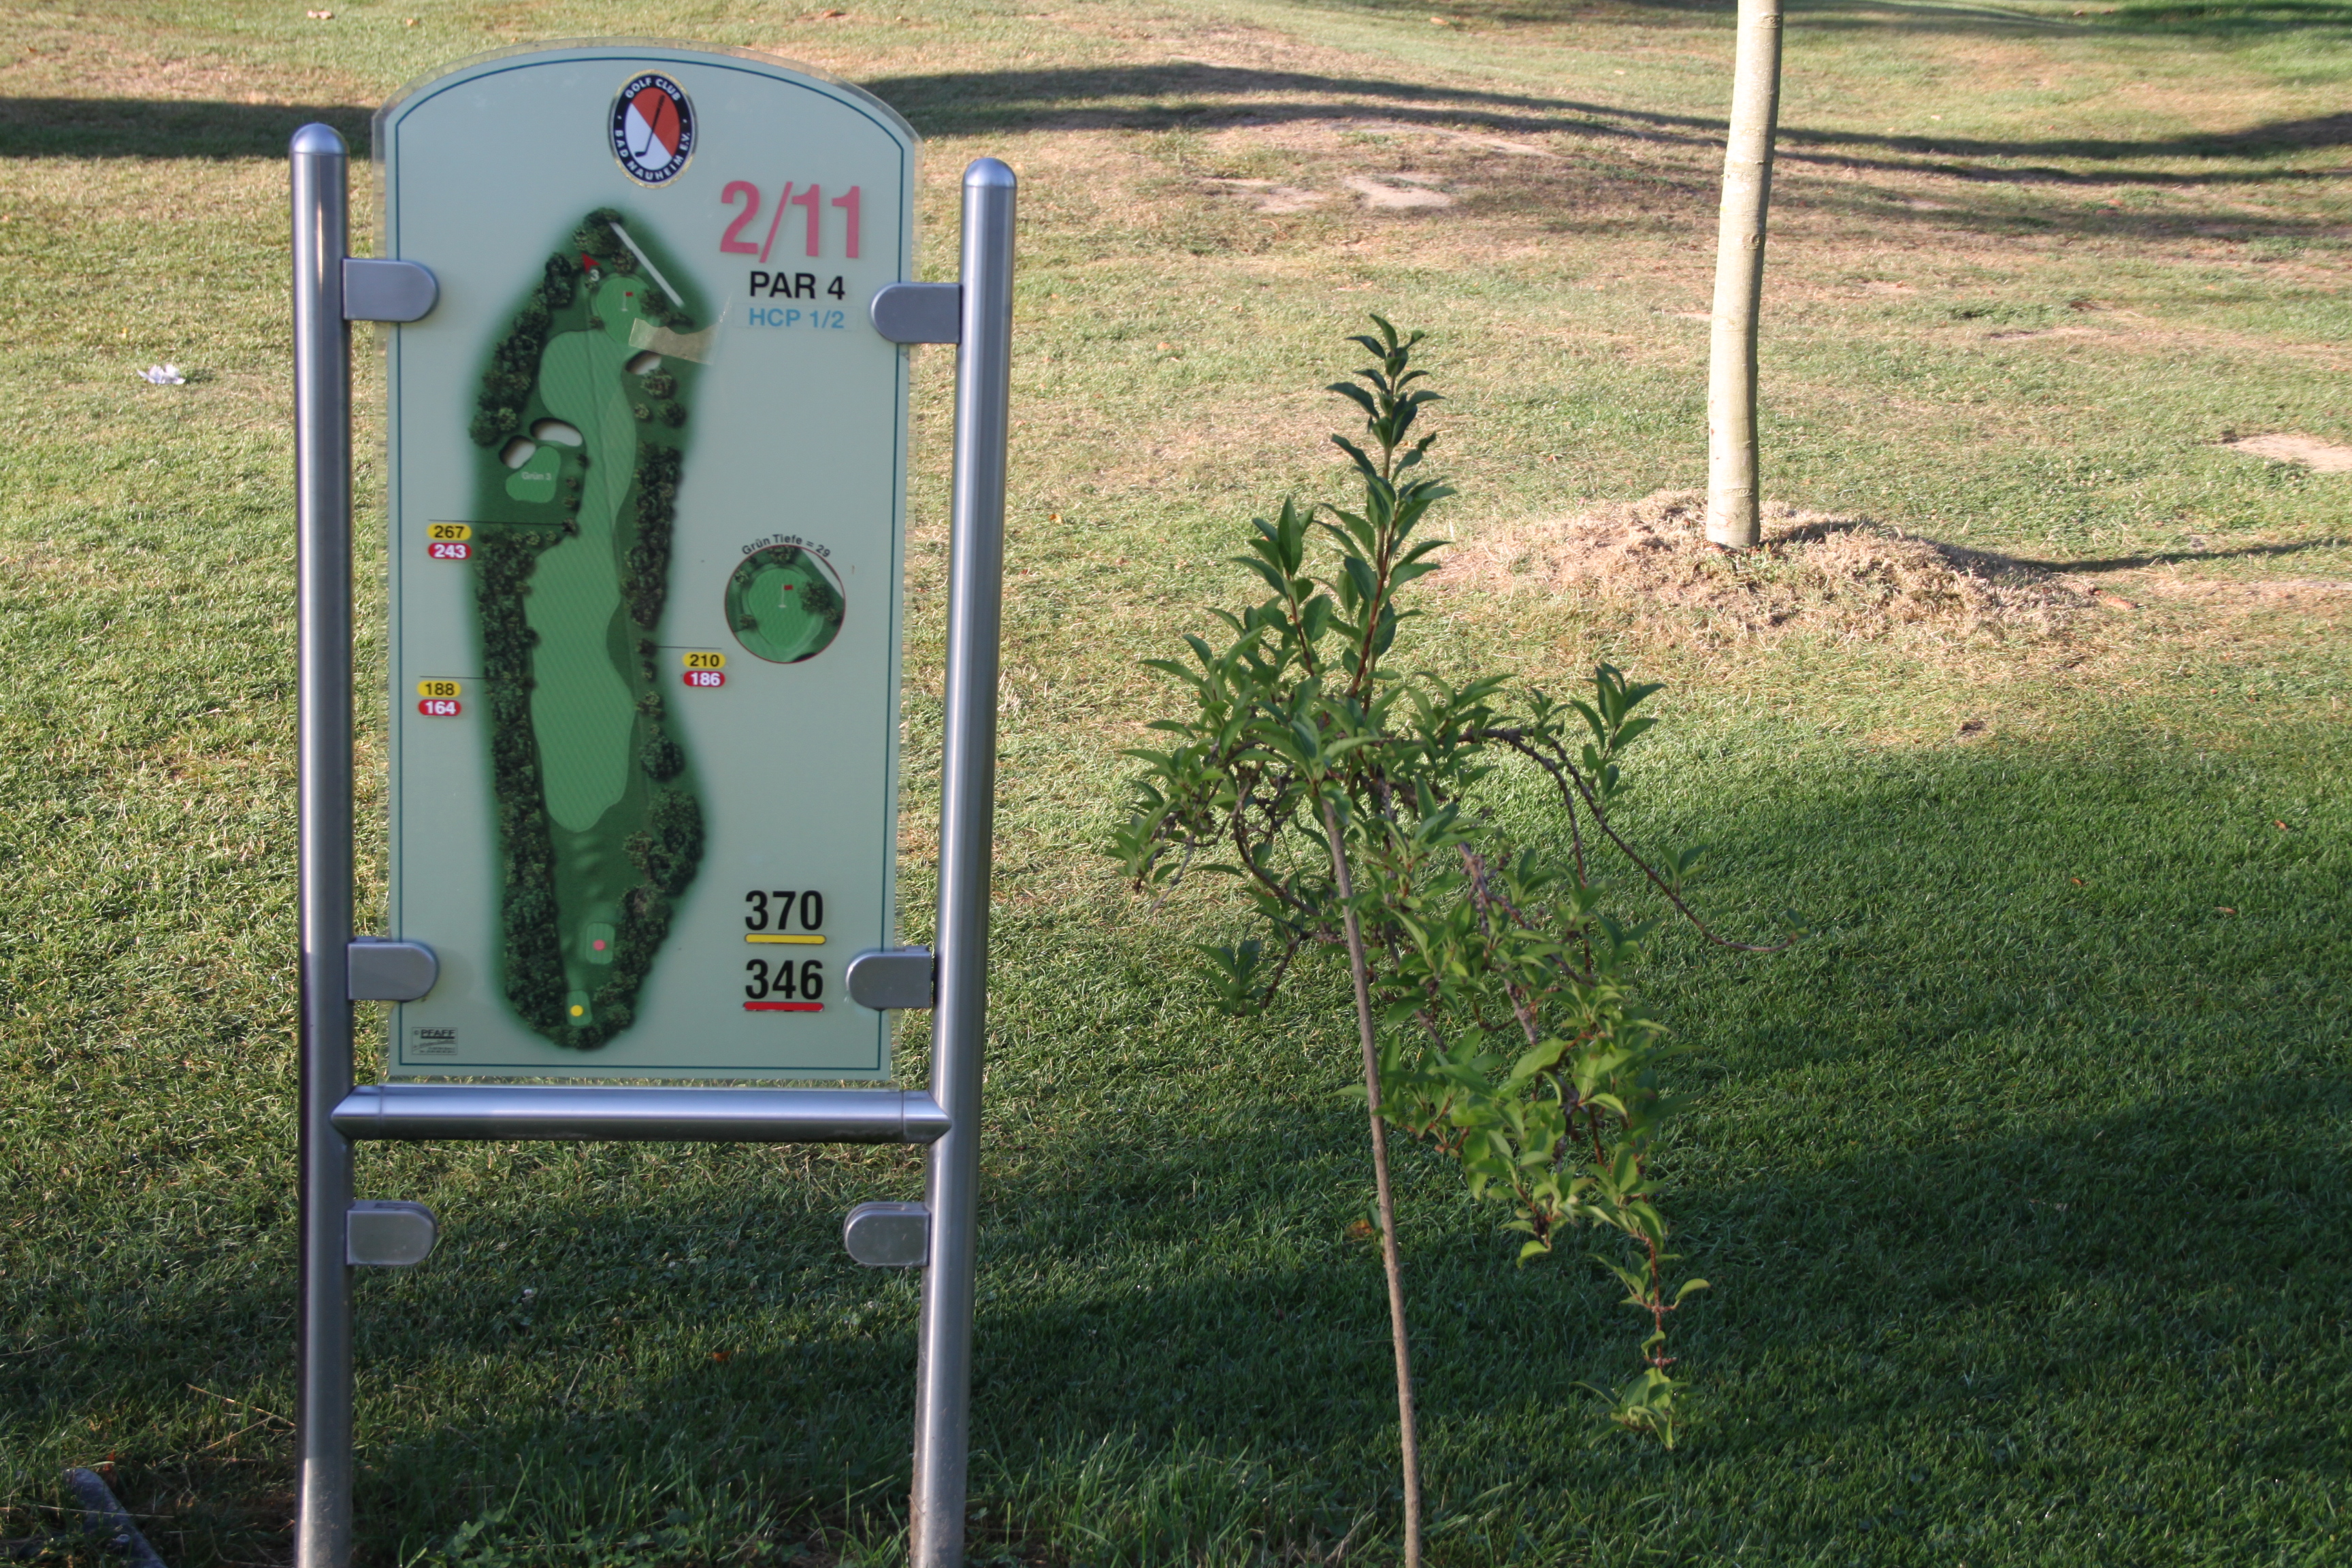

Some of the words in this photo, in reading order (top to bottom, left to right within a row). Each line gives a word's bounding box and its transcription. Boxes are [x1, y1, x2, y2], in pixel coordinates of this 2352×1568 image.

[625, 78, 652, 99] GOLF
[655, 78, 681, 101] CLUB
[615, 129, 629, 157] BAD
[720, 180, 860, 263] 2/11
[590, 269, 600, 282] 3
[749, 270, 816, 299] PAR
[827, 275, 846, 301] 4
[749, 307, 801, 327] HCP
[809, 310, 845, 329] 1/2
[434, 525, 465, 538] 267
[434, 544, 466, 558] 243
[742, 537, 770, 555] Grün
[772, 534, 802, 544] Tiefe
[815, 544, 831, 557] 29
[689, 654, 720, 667] 210
[425, 682, 455, 696] 188
[690, 672, 721, 686] 186
[425, 700, 457, 715] 164
[745, 889, 823, 930] 370
[745, 958, 823, 1000] 346
